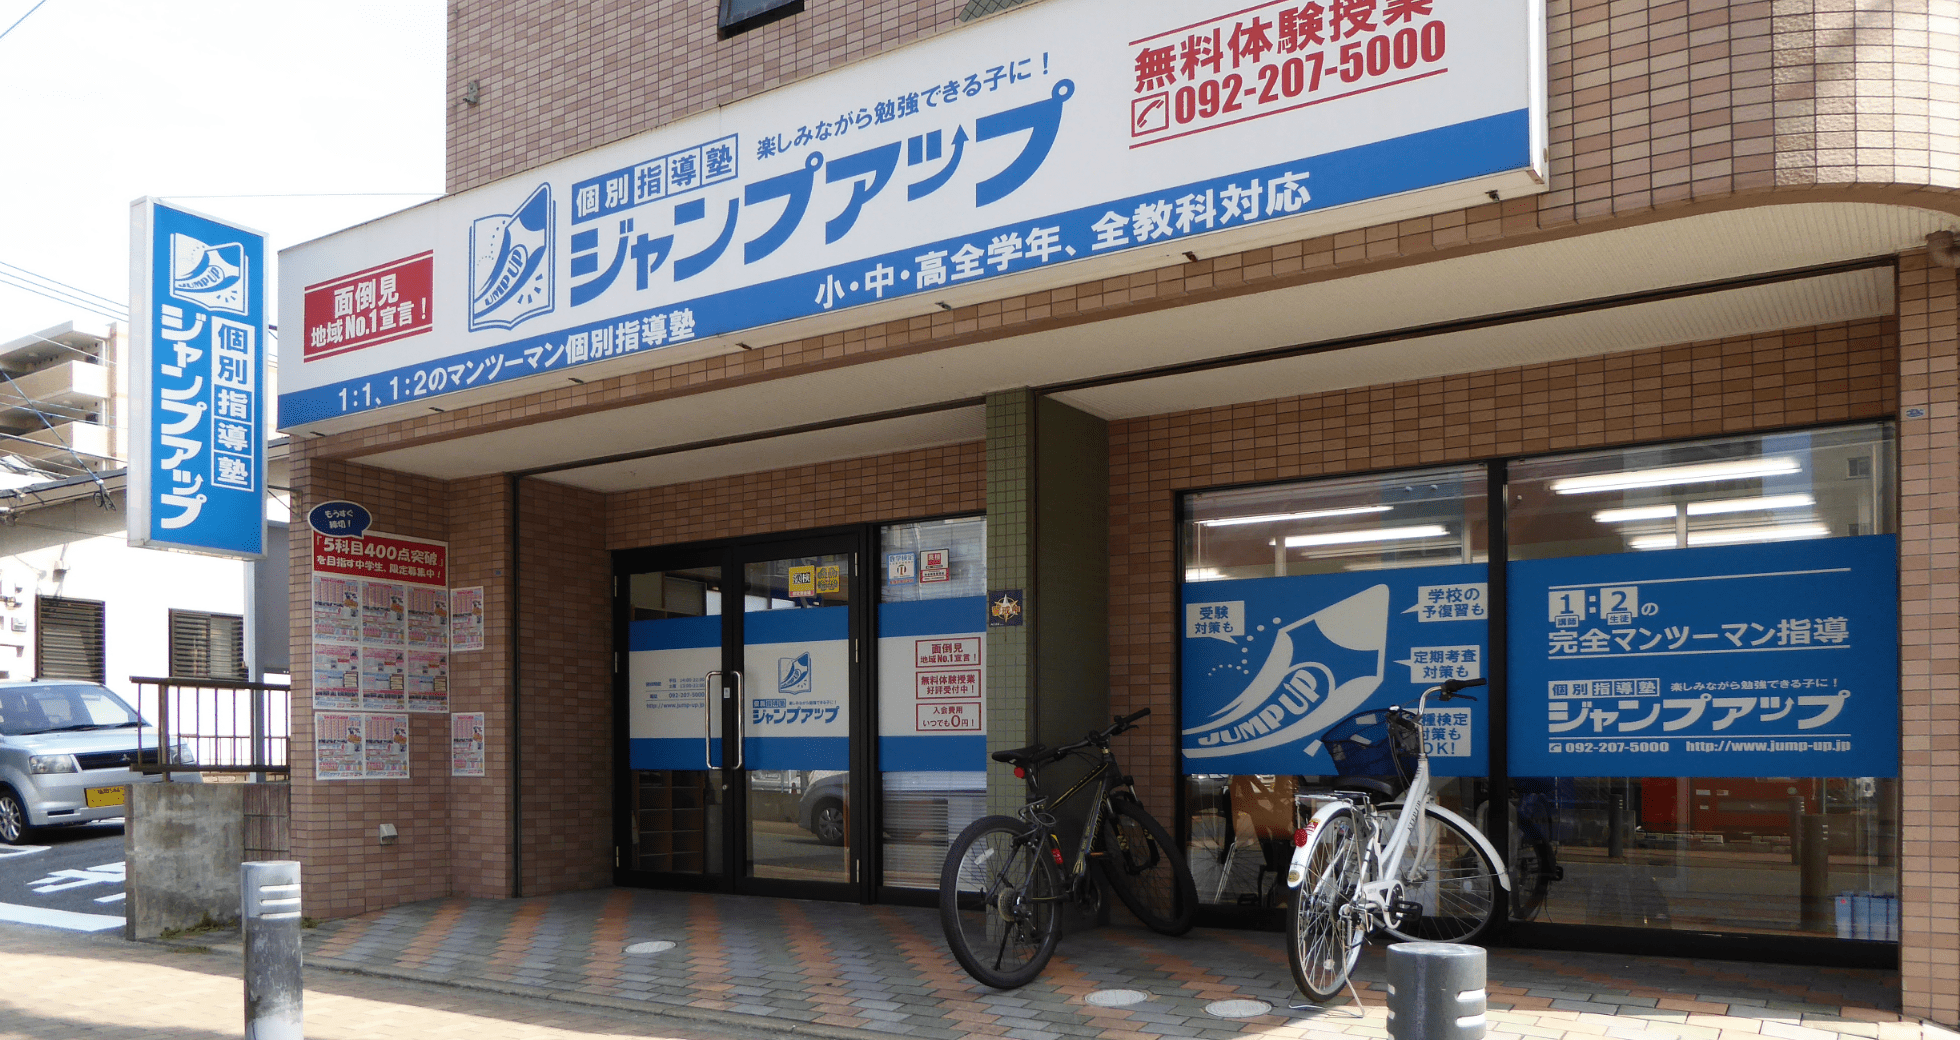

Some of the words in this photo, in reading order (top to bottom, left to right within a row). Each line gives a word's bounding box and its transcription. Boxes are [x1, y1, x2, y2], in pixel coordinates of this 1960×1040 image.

[1174, 19, 1446, 125] 092-207-5000
[756, 51, 1051, 161] 楽しみながら勉強できる子に!
[575, 143, 734, 219] 個別指導塾
[570, 78, 1076, 308] ジャンプアップ
[813, 170, 1312, 310] 小・中・高全学年、全教科対応
[333, 272, 400, 319] 面倒見
[310, 297, 428, 349] 地域No.1宣言!
[217, 321, 249, 487] 個別指導塾
[160, 303, 208, 530] ジャンプアップ
[324, 509, 354, 519] もうすぐ
[316, 554, 442, 579] を目指す中学生、限定募集中!
[1427, 587, 1480, 603] 学校の
[1199, 605, 1229, 620] 受験
[1421, 602, 1486, 619] 予復習も
[1194, 621, 1234, 635] 対策も
[1548, 616, 1850, 655] 完全マンツーマン指導
[931, 642, 964, 655] 面倒見
[1413, 649, 1477, 664] 定期考査
[920, 653, 976, 664] 地域No.1宣言!
[921, 674, 976, 685] 無料体験授業
[1422, 665, 1469, 680] 対策も
[926, 685, 975, 695] 好評受付中!
[1551, 680, 1658, 698] 個別指導塾
[1670, 678, 1839, 692] 楽しみながら勉強できる子に!
[752, 706, 840, 724] ジャンプアップ
[933, 706, 963, 715] 入会費用
[1548, 689, 1852, 733] ジャンプアップ
[922, 715, 974, 728] いつでも0円!
[1420, 712, 1469, 727] 種検定
[1565, 740, 1670, 753] 092-207-5000
[1685, 740, 1851, 753] http://www.jump-up.jp
